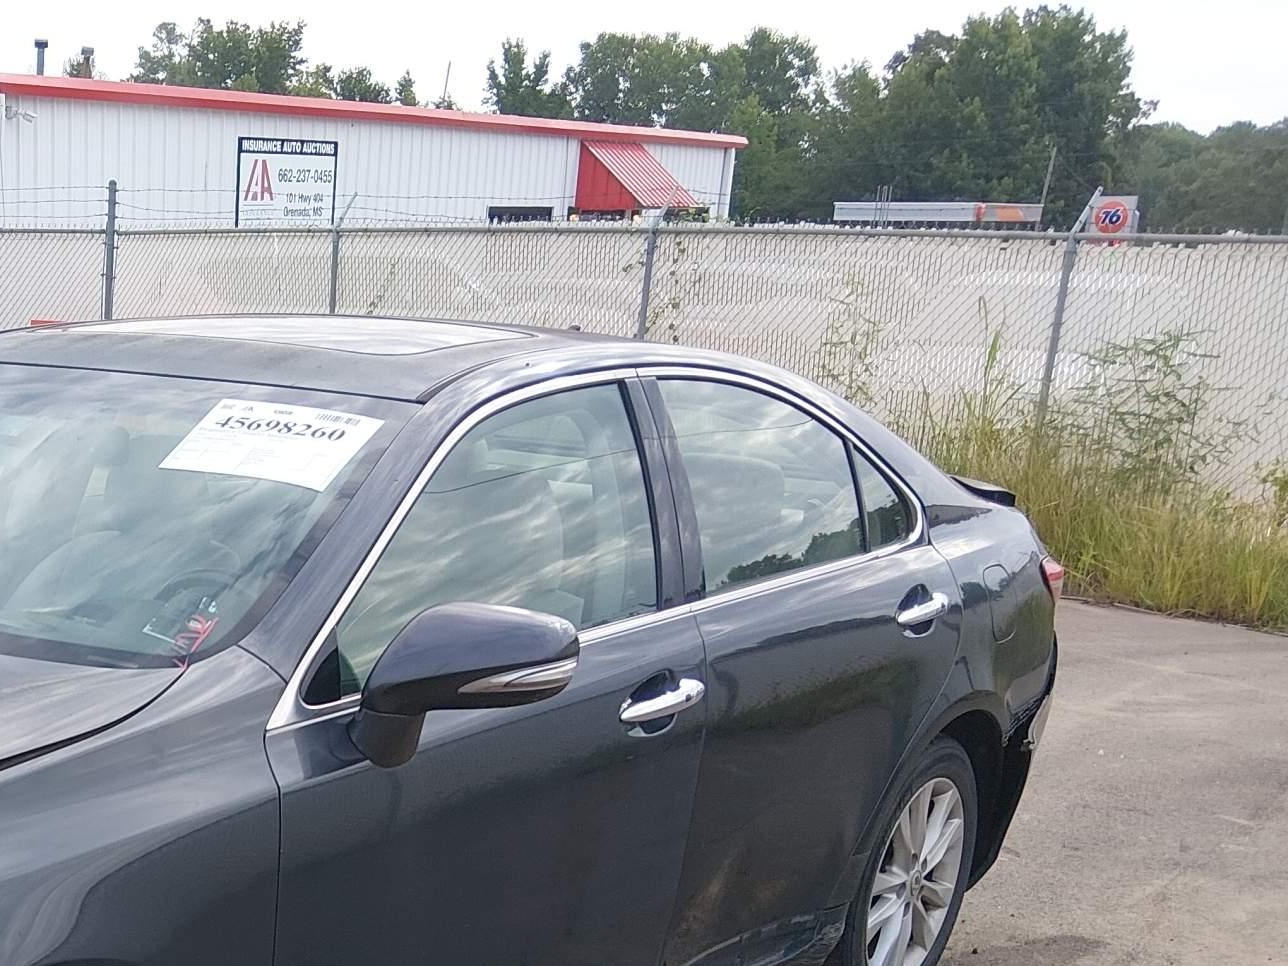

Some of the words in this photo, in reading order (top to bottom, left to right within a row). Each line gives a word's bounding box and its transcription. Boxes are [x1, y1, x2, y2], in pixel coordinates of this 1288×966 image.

[242, 139, 282, 152] INSURANCE
[282, 141, 301, 153] AUTO
[302, 141, 335, 154] AUCTIONS
[278, 168, 333, 183] 662-237-0455
[1099, 206, 1123, 225] 76
[215, 415, 347, 442] 45698260
